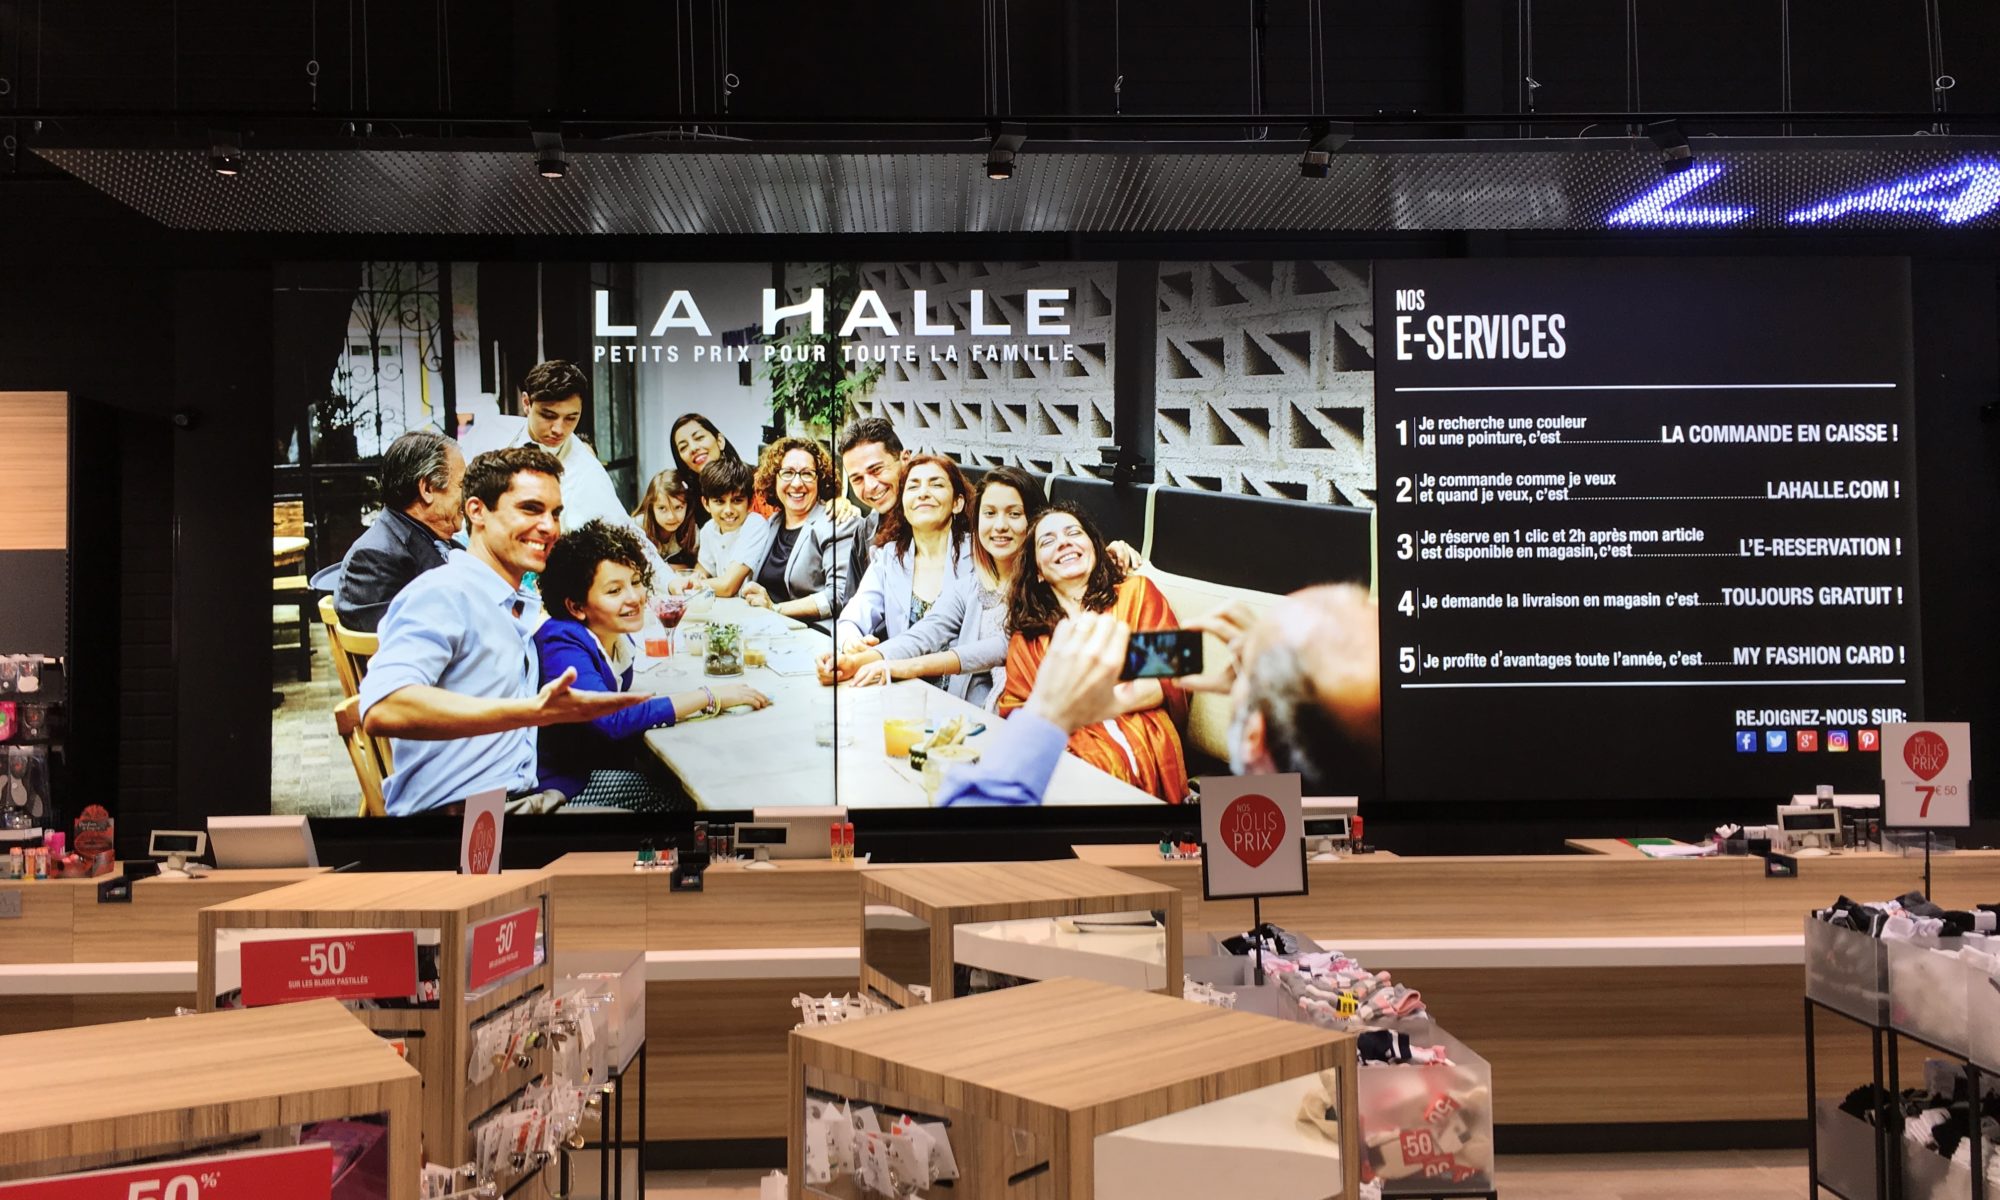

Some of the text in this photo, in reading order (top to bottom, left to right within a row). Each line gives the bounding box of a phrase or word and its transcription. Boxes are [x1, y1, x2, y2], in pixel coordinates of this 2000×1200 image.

[1396, 289, 1425, 311] NOS
[596, 289, 1070, 336] LA HALLE
[1397, 314, 1566, 360] E-SERVICES
[595, 344, 1073, 362] PETITS PRIX POUR TOUTE LA FAMILLE
[1419, 416, 1587, 430] Je recherche une couleur
[1396, 420, 1407, 445] 1
[1419, 434, 1435, 445] ou
[1440, 434, 1464, 445] une
[1468, 431, 1526, 446] pointure,
[1661, 425, 1684, 443] LA
[1689, 425, 1793, 443] COMMANDE
[1798, 425, 1820, 442] EN
[1825, 424, 1887, 442] CAISSE
[1420, 472, 1616, 486] Je commande comme je veux
[1396, 477, 1412, 502] 2
[1420, 489, 1433, 502] et
[1437, 488, 1478, 503] quand
[1481, 488, 1493, 503] je
[1497, 490, 1532, 503] veux,
[1767, 481, 1888, 499] LAHALLE.COM
[1421, 528, 1704, 544] Je réserve en 1 clic et 2h après mon article
[1397, 534, 1413, 559] 3
[1421, 546, 1442, 559] est
[1445, 544, 1513, 560] disponible
[1516, 547, 1532, 558] en
[1537, 544, 1597, 560] magasin,
[1739, 538, 1890, 556] L'E-RESERVATION
[1398, 591, 1414, 616] 4
[1422, 595, 1438, 608] Je
[1442, 594, 1503, 608] demande
[1507, 594, 1518, 607] la
[1523, 593, 1579, 607] livraison
[1583, 596, 1599, 607] en
[1604, 592, 1660, 609] magasin
[1722, 587, 1814, 606] TOUJOURS
[1819, 587, 1892, 605] GRATUIT
[1400, 647, 1415, 673] 5
[1423, 654, 1439, 668] Je
[1443, 653, 1487, 669] profite
[1491, 650, 1571, 669] d'avantages
[1575, 653, 1610, 666] toute
[1614, 651, 1666, 668] l'année,
[1733, 647, 1760, 665] MY
[1766, 646, 1841, 665] FASHION
[1846, 646, 1894, 664] CARD
[1736, 709, 1907, 726] REJOIGNEZ-NOUS SUR:
[1912, 743, 1944, 757] JOLIS
[1912, 756, 1940, 770] PRIX
[1236, 804, 1250, 812] NOS
[1915, 786, 1936, 818] 7
[1232, 811, 1277, 833] JOLIS
[1234, 831, 1272, 852] PRIX
[314, 978, 336, 987] BIJOUX
